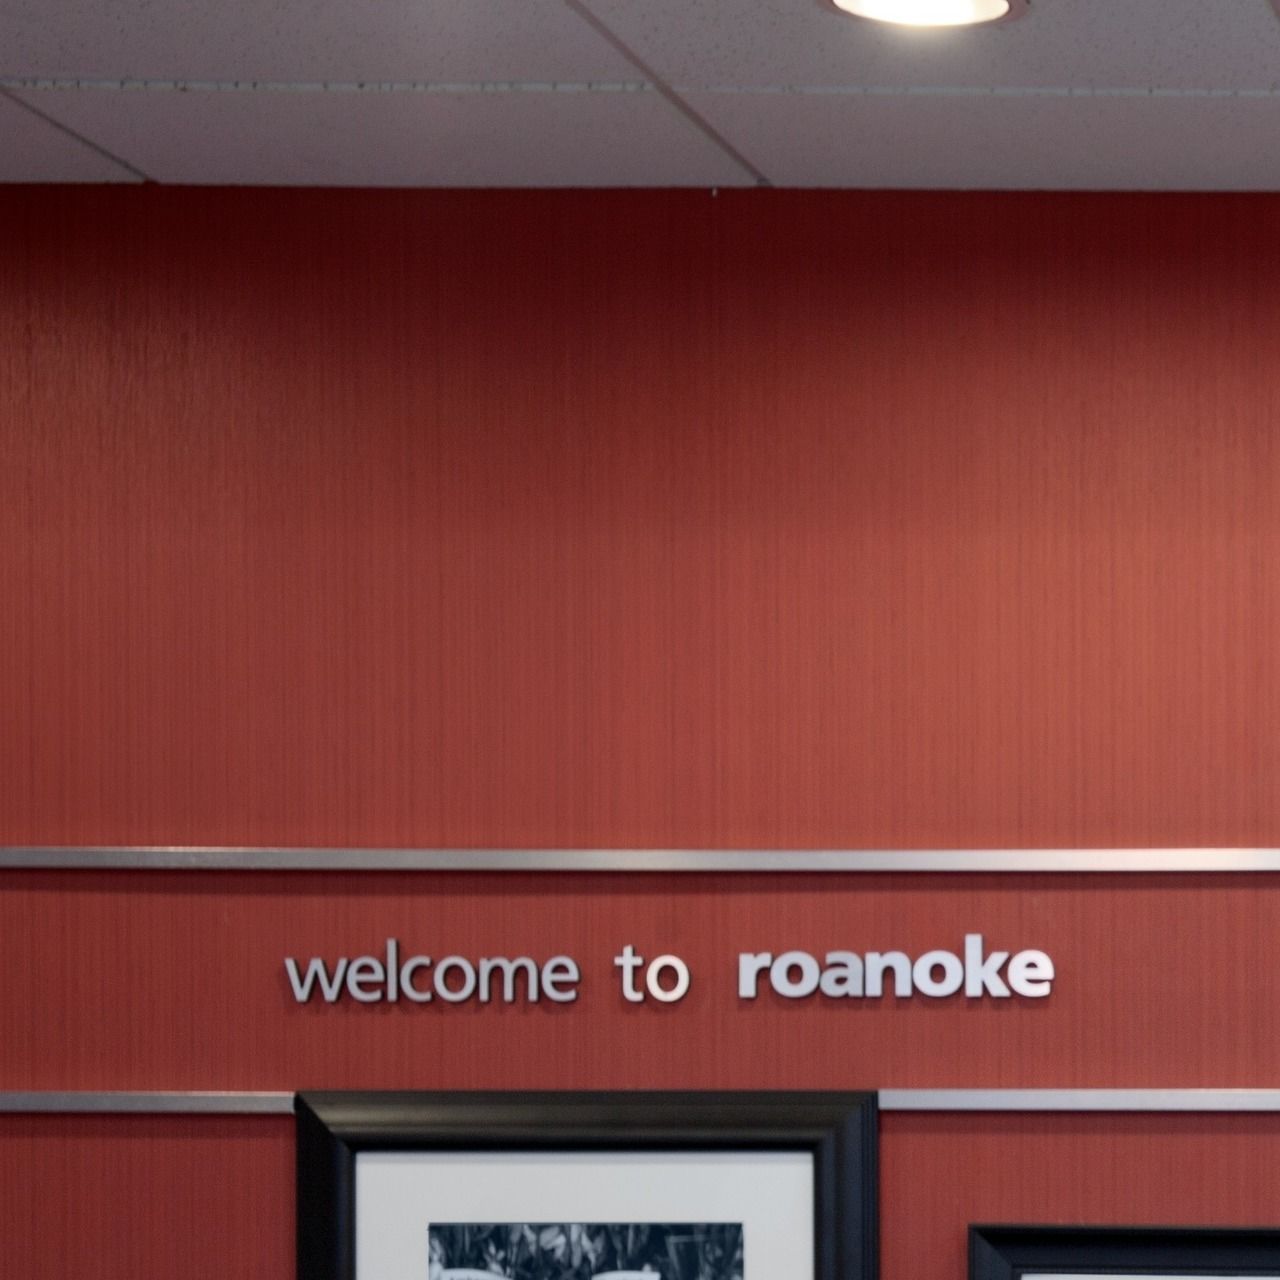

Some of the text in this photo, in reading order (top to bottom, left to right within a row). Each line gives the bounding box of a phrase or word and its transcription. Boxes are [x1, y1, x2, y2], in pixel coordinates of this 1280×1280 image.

[285, 935, 1055, 1004] welcome to roanoke
